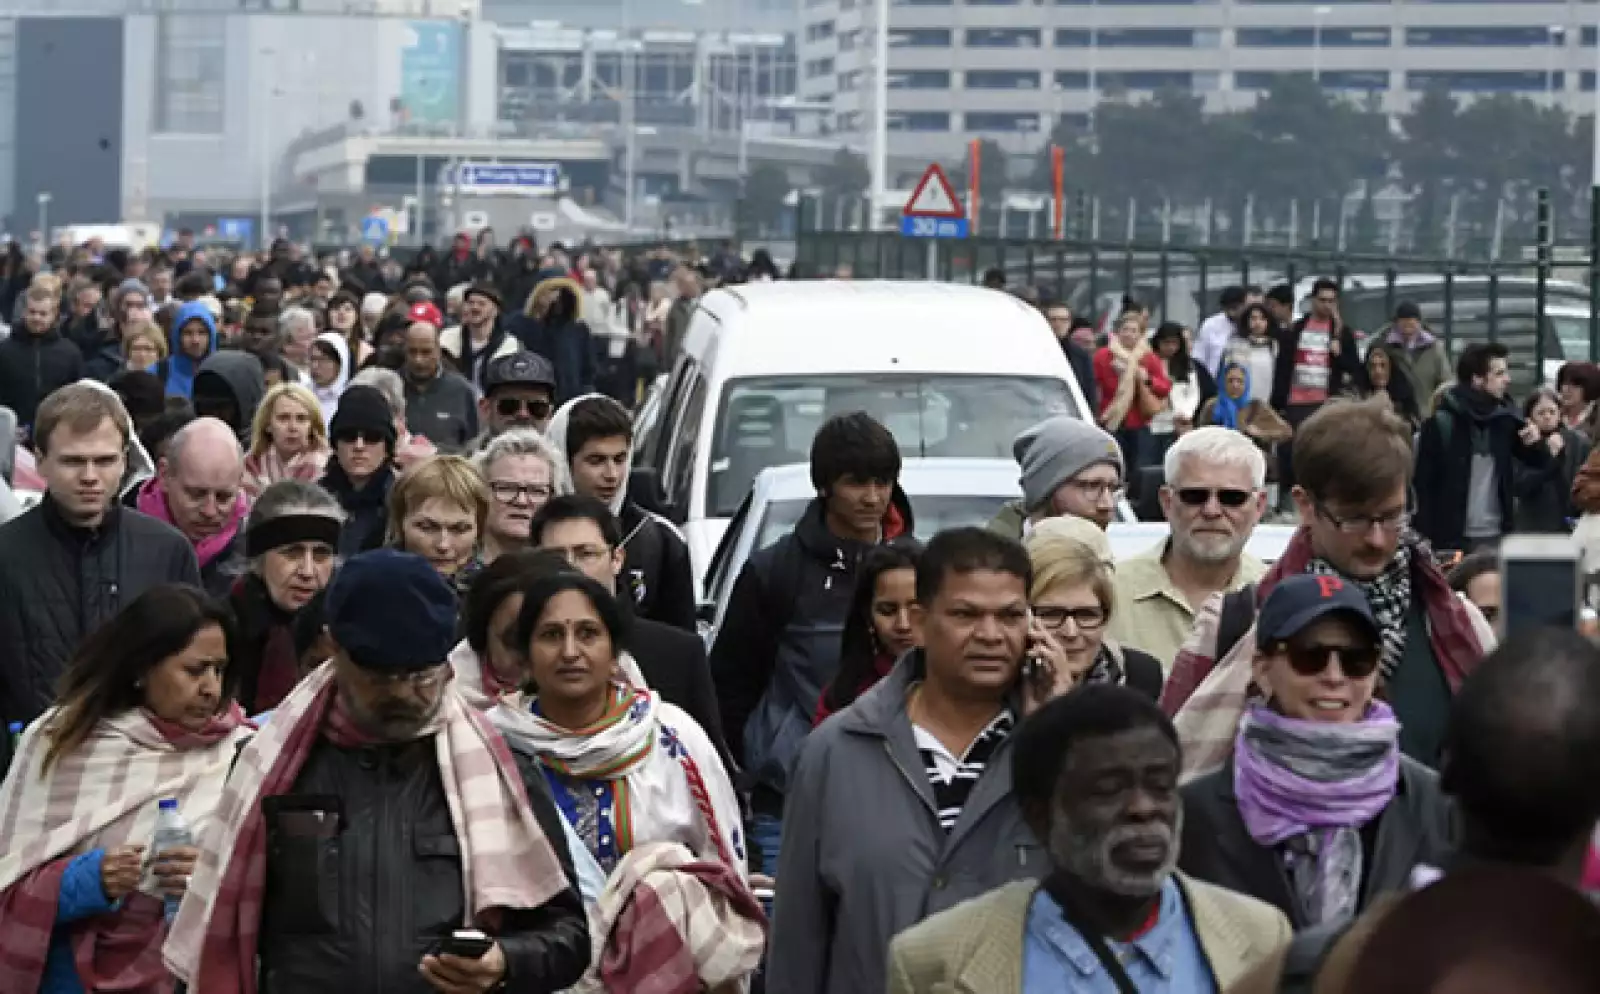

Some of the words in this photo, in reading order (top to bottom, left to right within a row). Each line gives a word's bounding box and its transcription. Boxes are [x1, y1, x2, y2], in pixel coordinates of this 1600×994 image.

[912, 218, 937, 236] 30
[939, 222, 959, 236] m
[1316, 576, 1343, 597] P
